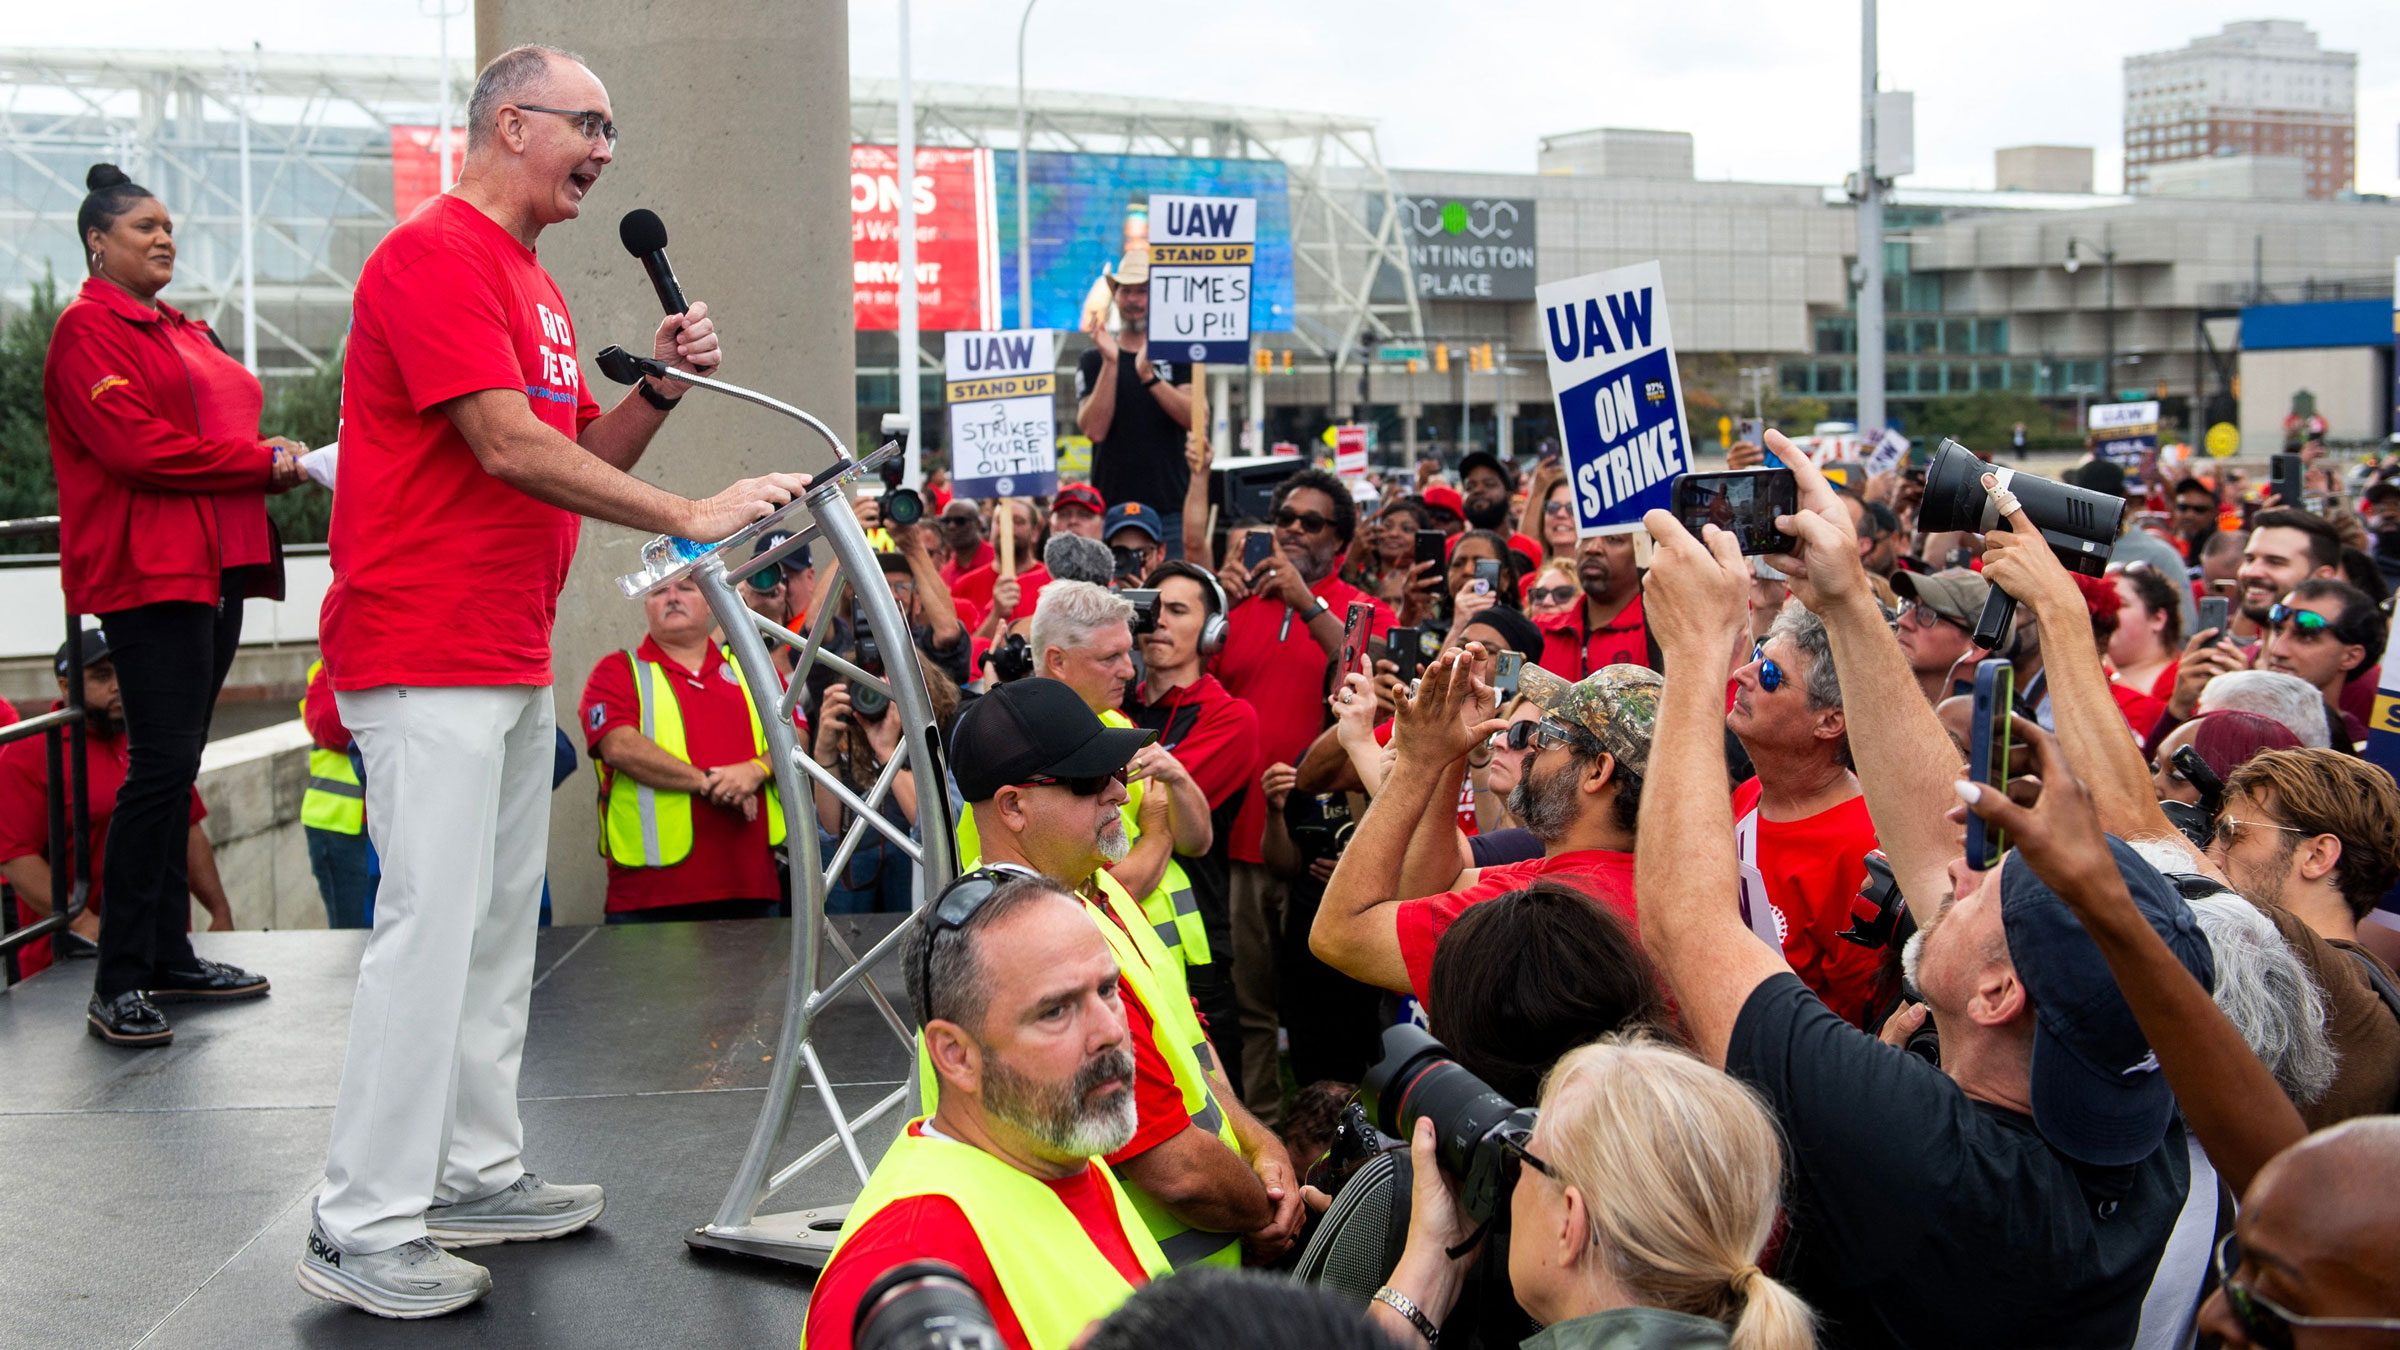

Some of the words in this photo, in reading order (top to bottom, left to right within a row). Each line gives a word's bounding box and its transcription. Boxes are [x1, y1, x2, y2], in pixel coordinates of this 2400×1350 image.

[1168, 202, 1238, 237] UAW
[1155, 249, 1216, 261] STAND
[1223, 249, 1247, 260] UP
[1410, 246, 1534, 268] NTINGTON
[854, 261, 941, 284] BRYNT
[1155, 274, 1246, 303] TIME'S
[1418, 273, 1492, 296] PLACE
[1546, 287, 1652, 362] UAW
[965, 336, 1034, 371] UAW
[954, 384, 1016, 398] STAND
[1023, 379, 1047, 391] UP
[990, 403, 1006, 422] 3
[1594, 374, 1639, 443] ON
[962, 420, 1048, 441] STRIKES
[977, 454, 1046, 475] OUT!!!
[1577, 418, 1682, 519] STRIKE
[307, 1229, 341, 1269] HOKA
